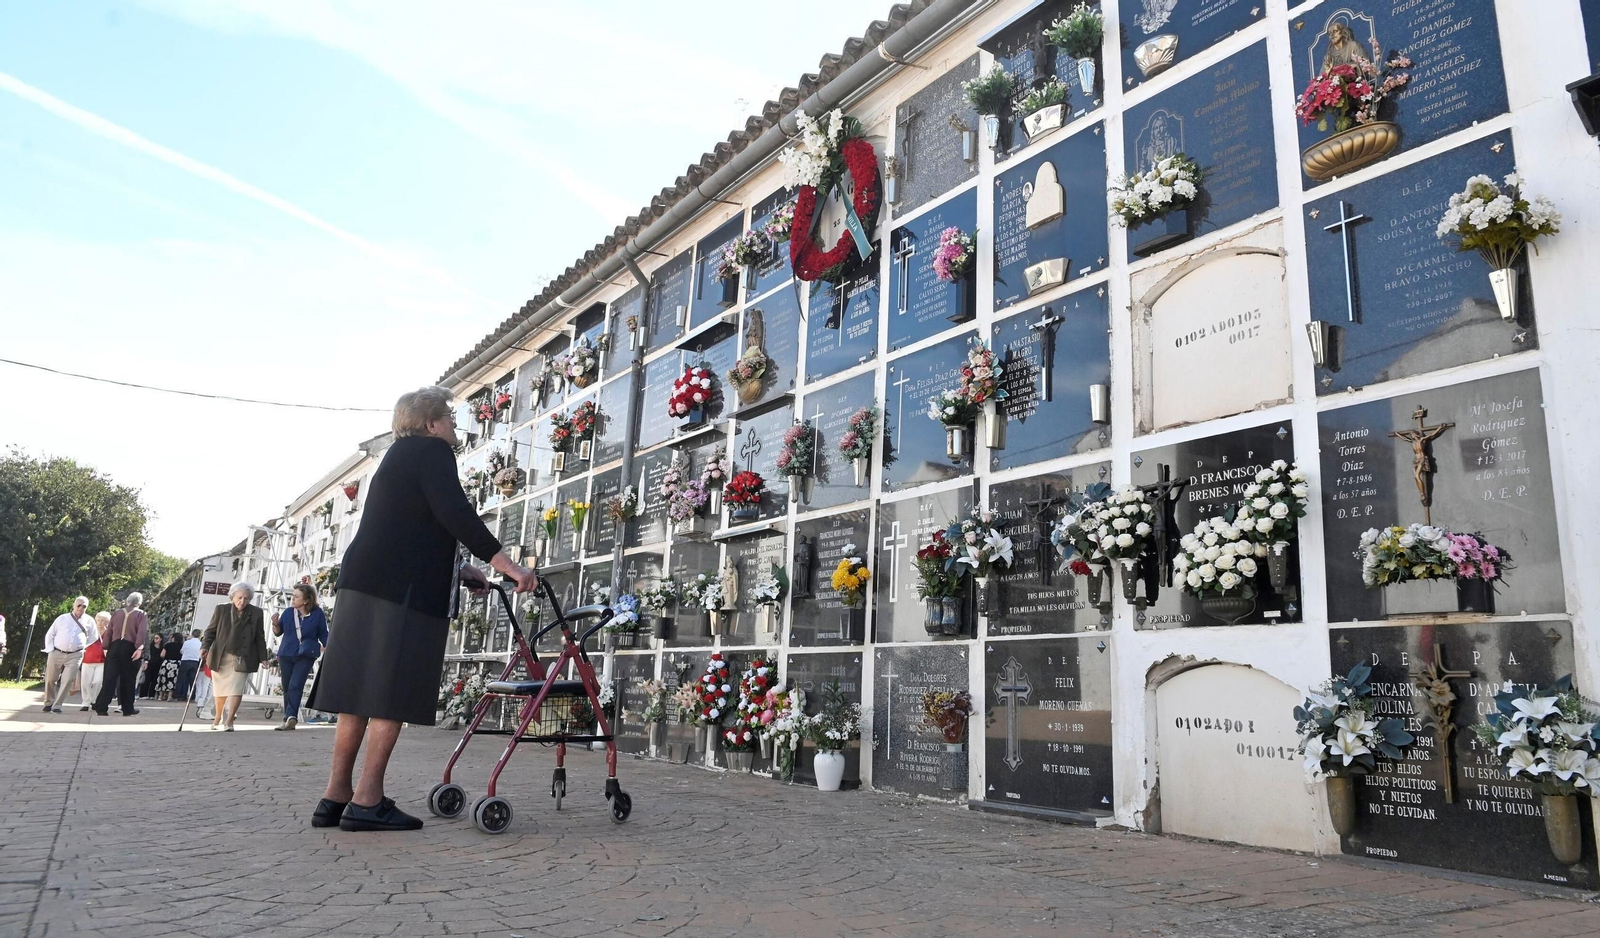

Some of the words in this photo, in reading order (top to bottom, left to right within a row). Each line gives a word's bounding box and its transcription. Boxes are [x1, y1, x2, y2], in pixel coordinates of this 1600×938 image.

[1414, 15, 1427, 25] LOS
[1398, 33, 1437, 56] SANCHEZ
[1439, 17, 1473, 38] GOMEZ
[1419, 58, 1432, 68] LOS
[1424, 53, 1467, 79] ANGELES
[1399, 78, 1437, 101] MADERO
[1439, 58, 1482, 84] SANCHEZ
[1002, 186, 1022, 204] ANDRES
[1001, 198, 1022, 212] GARCIA
[1377, 226, 1412, 243] SOUSA
[1384, 275, 1420, 291] BRAVO
[1424, 259, 1472, 280] SANCHO
[1009, 332, 1041, 351] ANASTASIO
[1012, 346, 1032, 360] MAGRO
[1489, 396, 1523, 415] Josefa
[1332, 427, 1369, 449] Antonio
[1482, 436, 1519, 454] Gómez
[1338, 444, 1366, 458] Torres
[1197, 460, 1204, 468] D
[1222, 455, 1229, 463] E
[1248, 450, 1255, 459] P
[1201, 464, 1264, 485] FRANCISCO
[1482, 469, 1496, 480] los
[1189, 485, 1230, 502] BRENES
[1339, 489, 1349, 500] los
[1350, 489, 1360, 499] 57
[1360, 487, 1378, 498] años
[1003, 509, 1023, 519] JUAN
[1039, 591, 1055, 600] HIJOS
[1056, 589, 1080, 598] NIETOS
[1014, 604, 1037, 614] FAMILIA
[1058, 601, 1086, 611] OLVIDAN
[1001, 625, 1032, 634] PROPIEDAD
[1055, 677, 1075, 688] FELIX
[1038, 700, 1065, 711] MORENO
[1066, 701, 1093, 712] CUEVAS
[1416, 735, 1434, 748] 1991
[1236, 742, 1295, 761] 010017
[1476, 755, 1482, 766] A
[1042, 763, 1050, 772] NO
[1052, 764, 1059, 774] TE
[1376, 761, 1392, 773] TUS
[1396, 763, 1422, 775] HIJOS
[1463, 766, 1475, 779] TU
[1365, 775, 1389, 787] HIJOS
[1391, 777, 1437, 791] POLITICOS
[1379, 790, 1386, 801] Y
[1391, 791, 1422, 804] NIETOS
[1477, 784, 1489, 796] TE
[1491, 786, 1533, 800] QUIEREN
[1369, 803, 1381, 814] NO
[1383, 805, 1395, 816] TE
[1467, 799, 1473, 810] Y
[1475, 800, 1489, 812] NO
[1491, 801, 1503, 813] TE
[1366, 846, 1399, 858] PROPIEDAD
